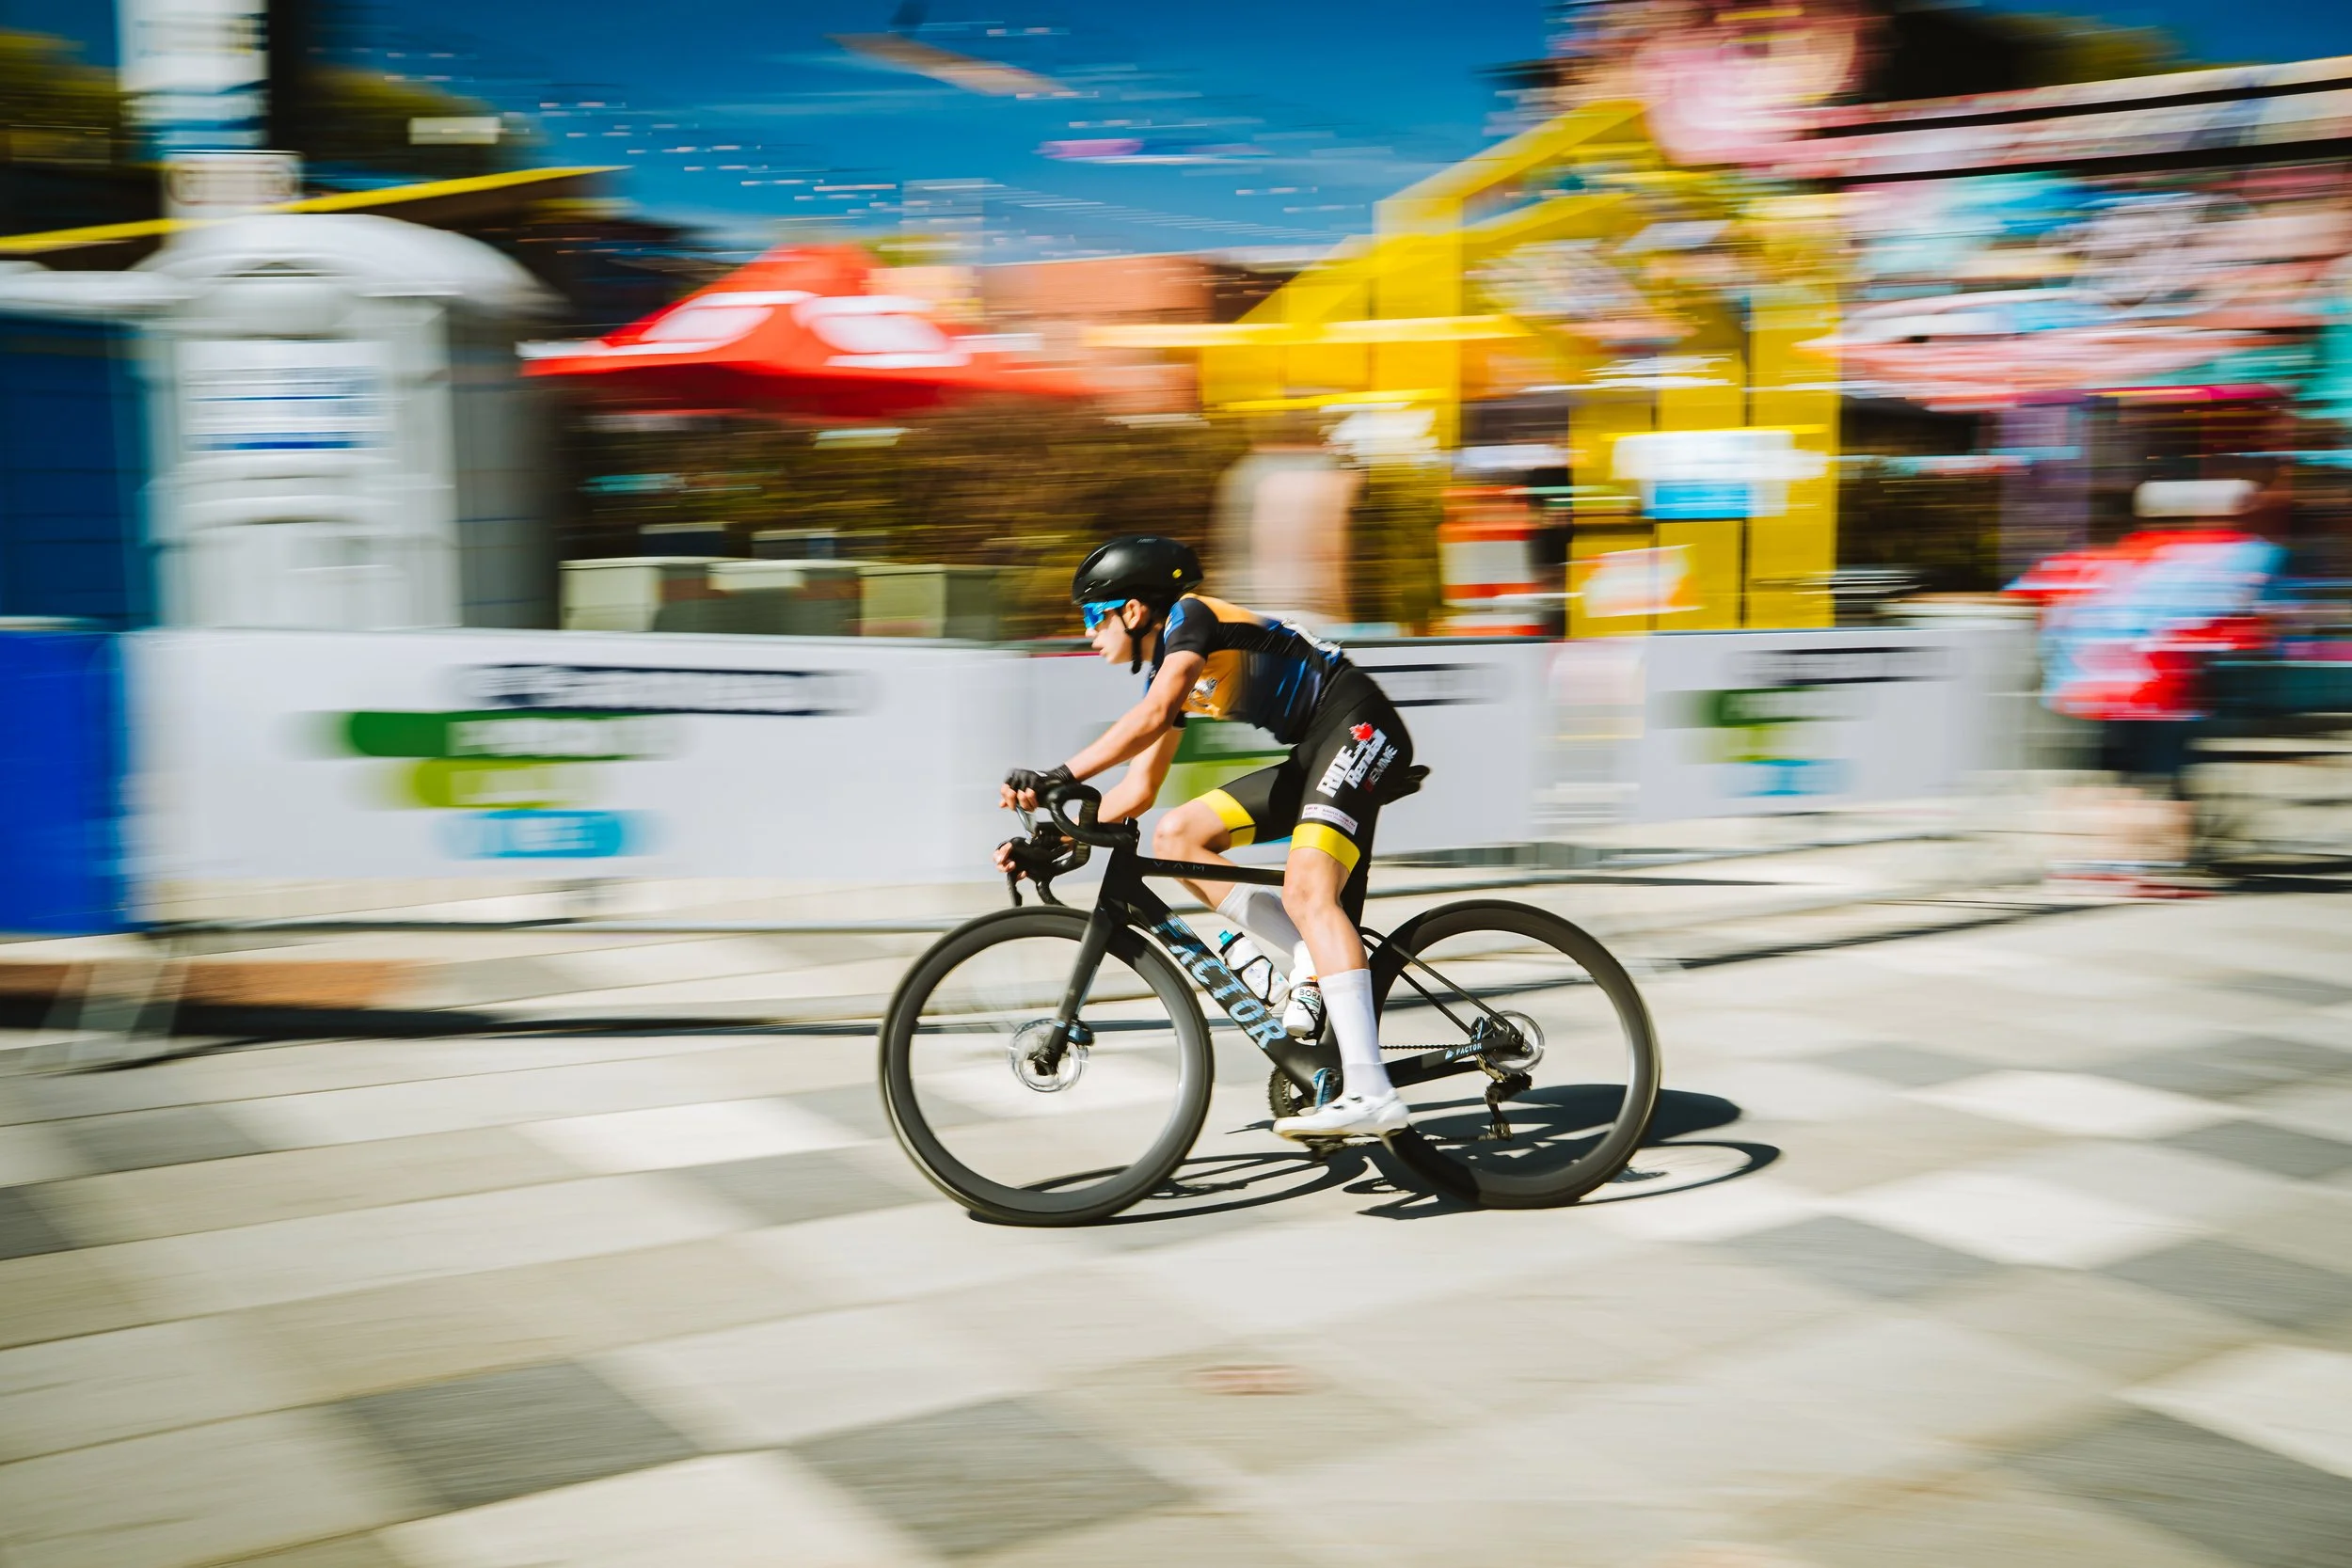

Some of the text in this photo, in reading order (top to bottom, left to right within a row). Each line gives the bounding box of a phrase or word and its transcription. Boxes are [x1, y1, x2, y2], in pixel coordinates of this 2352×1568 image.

[1316, 745, 1354, 799] RIDE
[1150, 916, 1288, 1050] FACTOR
[1299, 989, 1322, 1005] BORA
[1455, 1043, 1483, 1055] FACTOR
